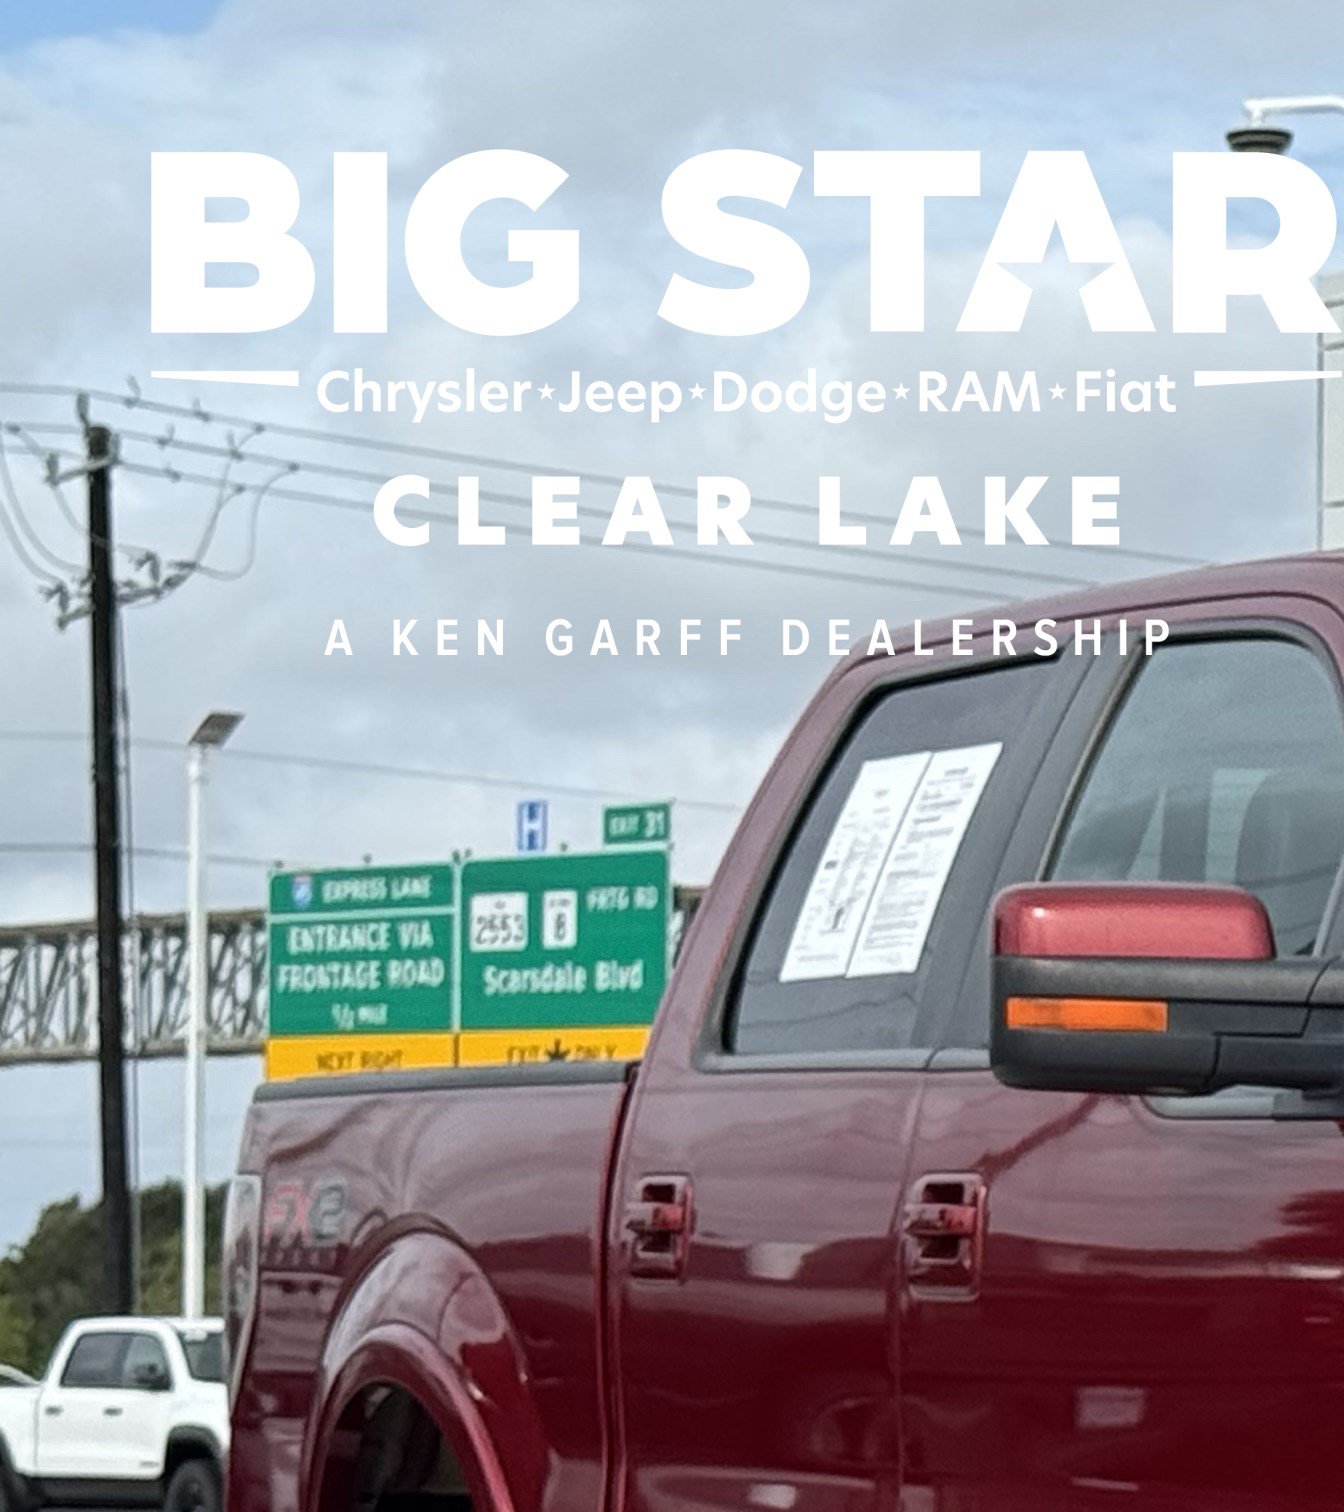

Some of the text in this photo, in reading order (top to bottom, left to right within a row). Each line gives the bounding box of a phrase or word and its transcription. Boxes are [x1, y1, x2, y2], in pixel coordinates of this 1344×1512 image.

[322, 876, 387, 903] EXPRESS
[391, 875, 432, 900] LANE
[286, 919, 435, 955] ENTRANCE VIA
[276, 956, 445, 993] FRONTAGE ROAD
[483, 959, 644, 998] Scarsdale Blvd
